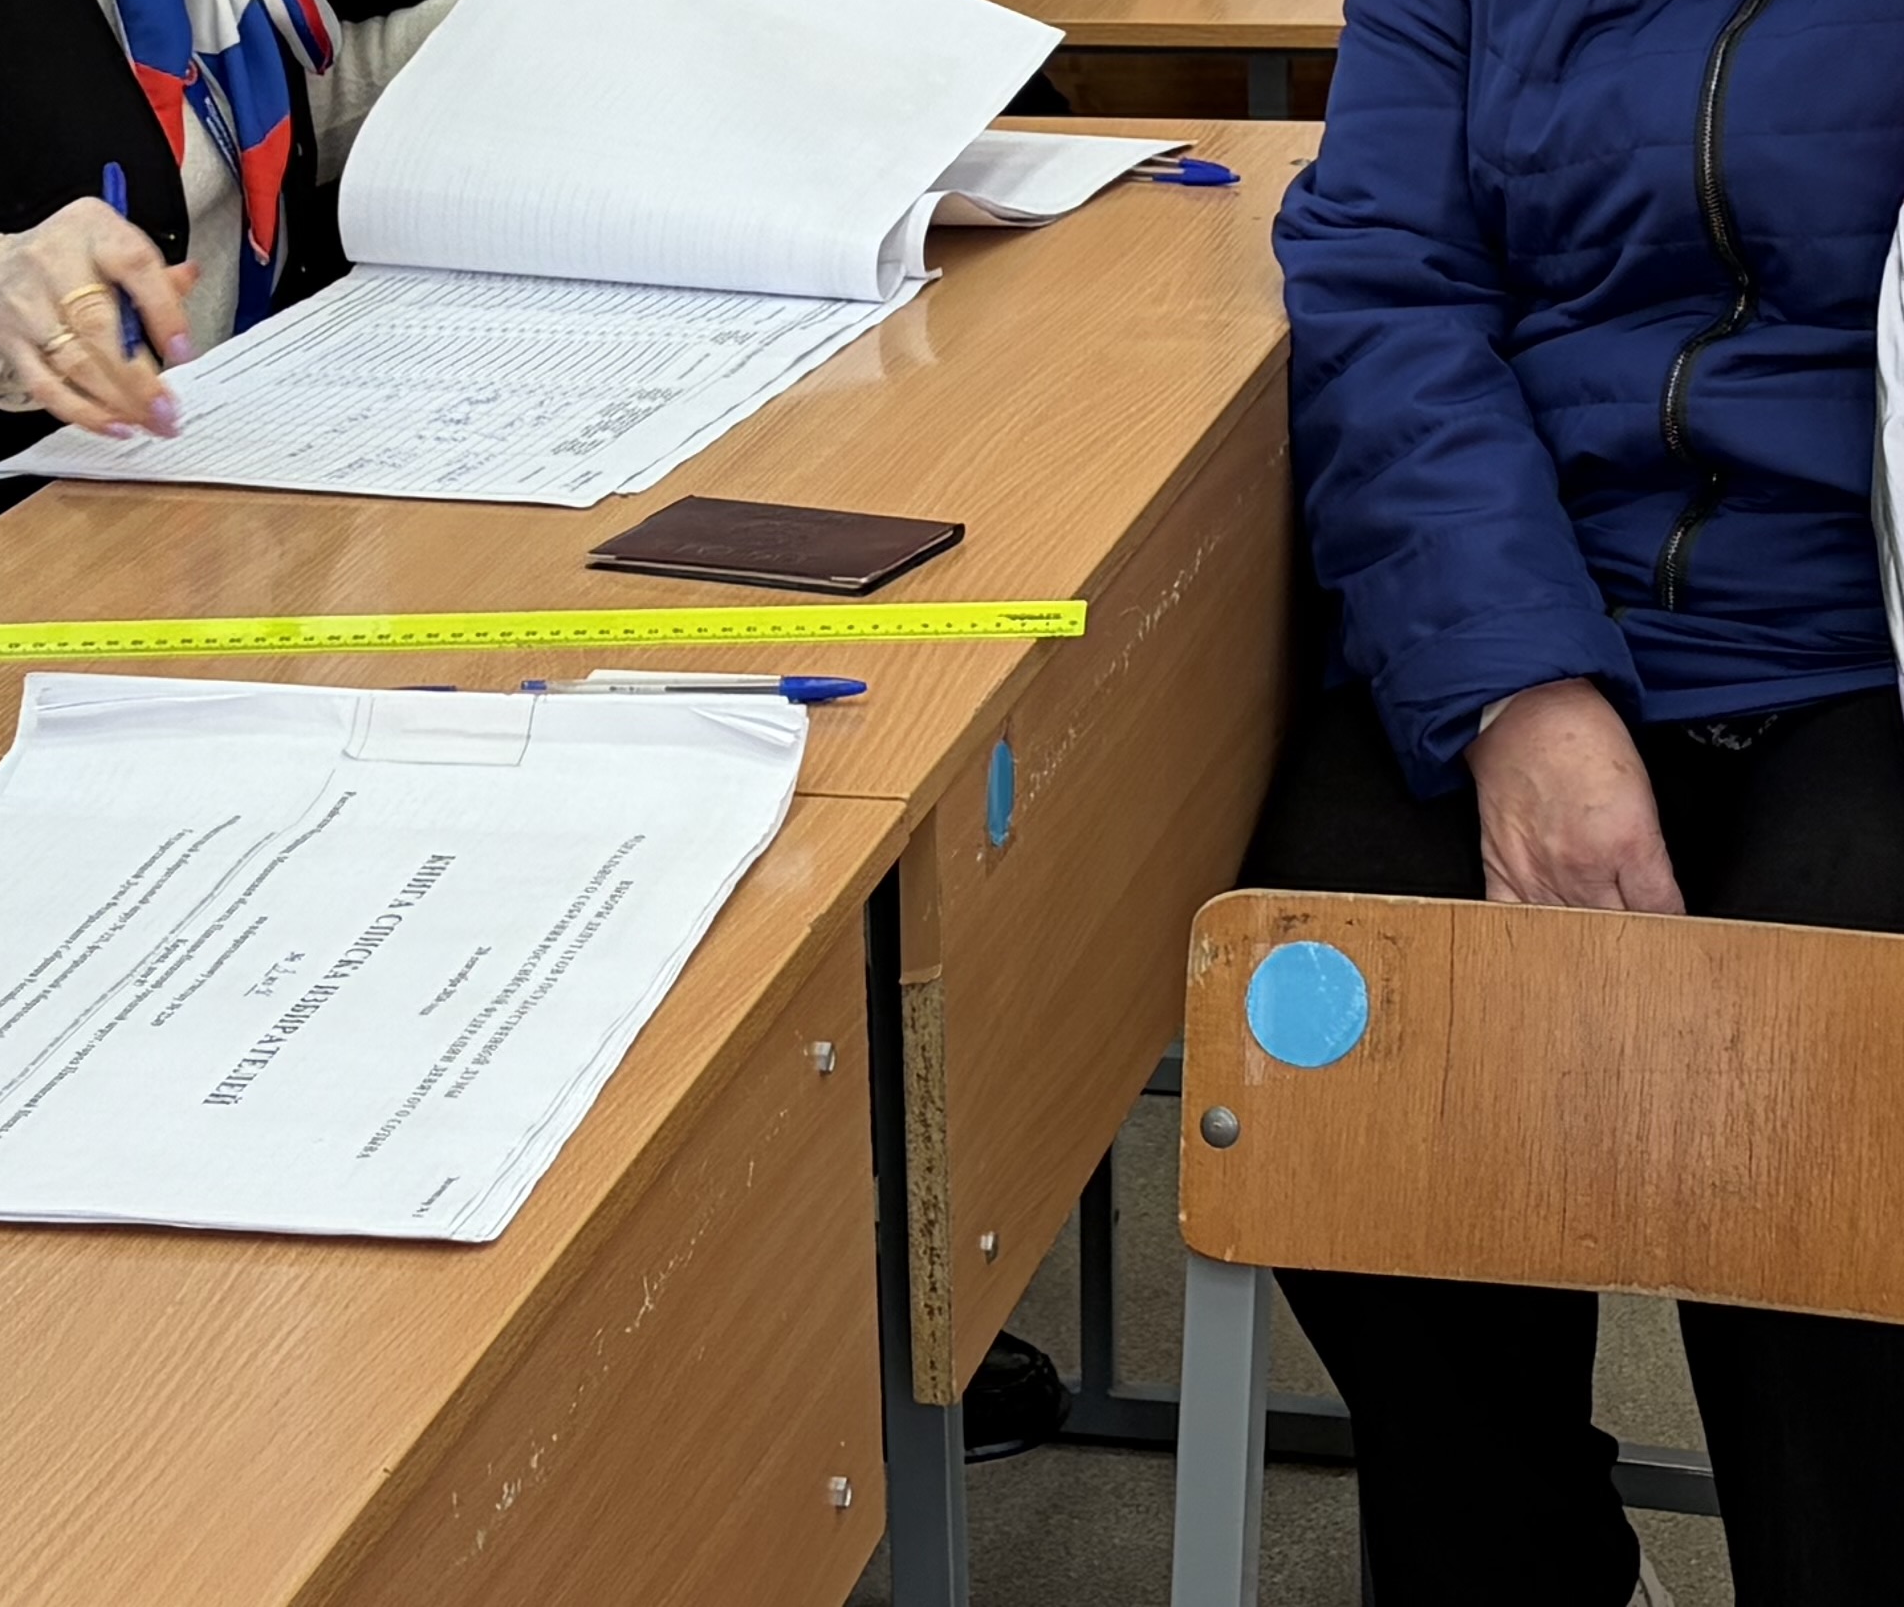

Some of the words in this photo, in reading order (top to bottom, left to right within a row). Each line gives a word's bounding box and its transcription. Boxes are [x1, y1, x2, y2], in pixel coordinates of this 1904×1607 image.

[388, 854, 456, 908] КНИГА
[322, 913, 403, 980] СПИСКА
[202, 984, 340, 1105] ИЗБИРАТЕЛЕЙ
